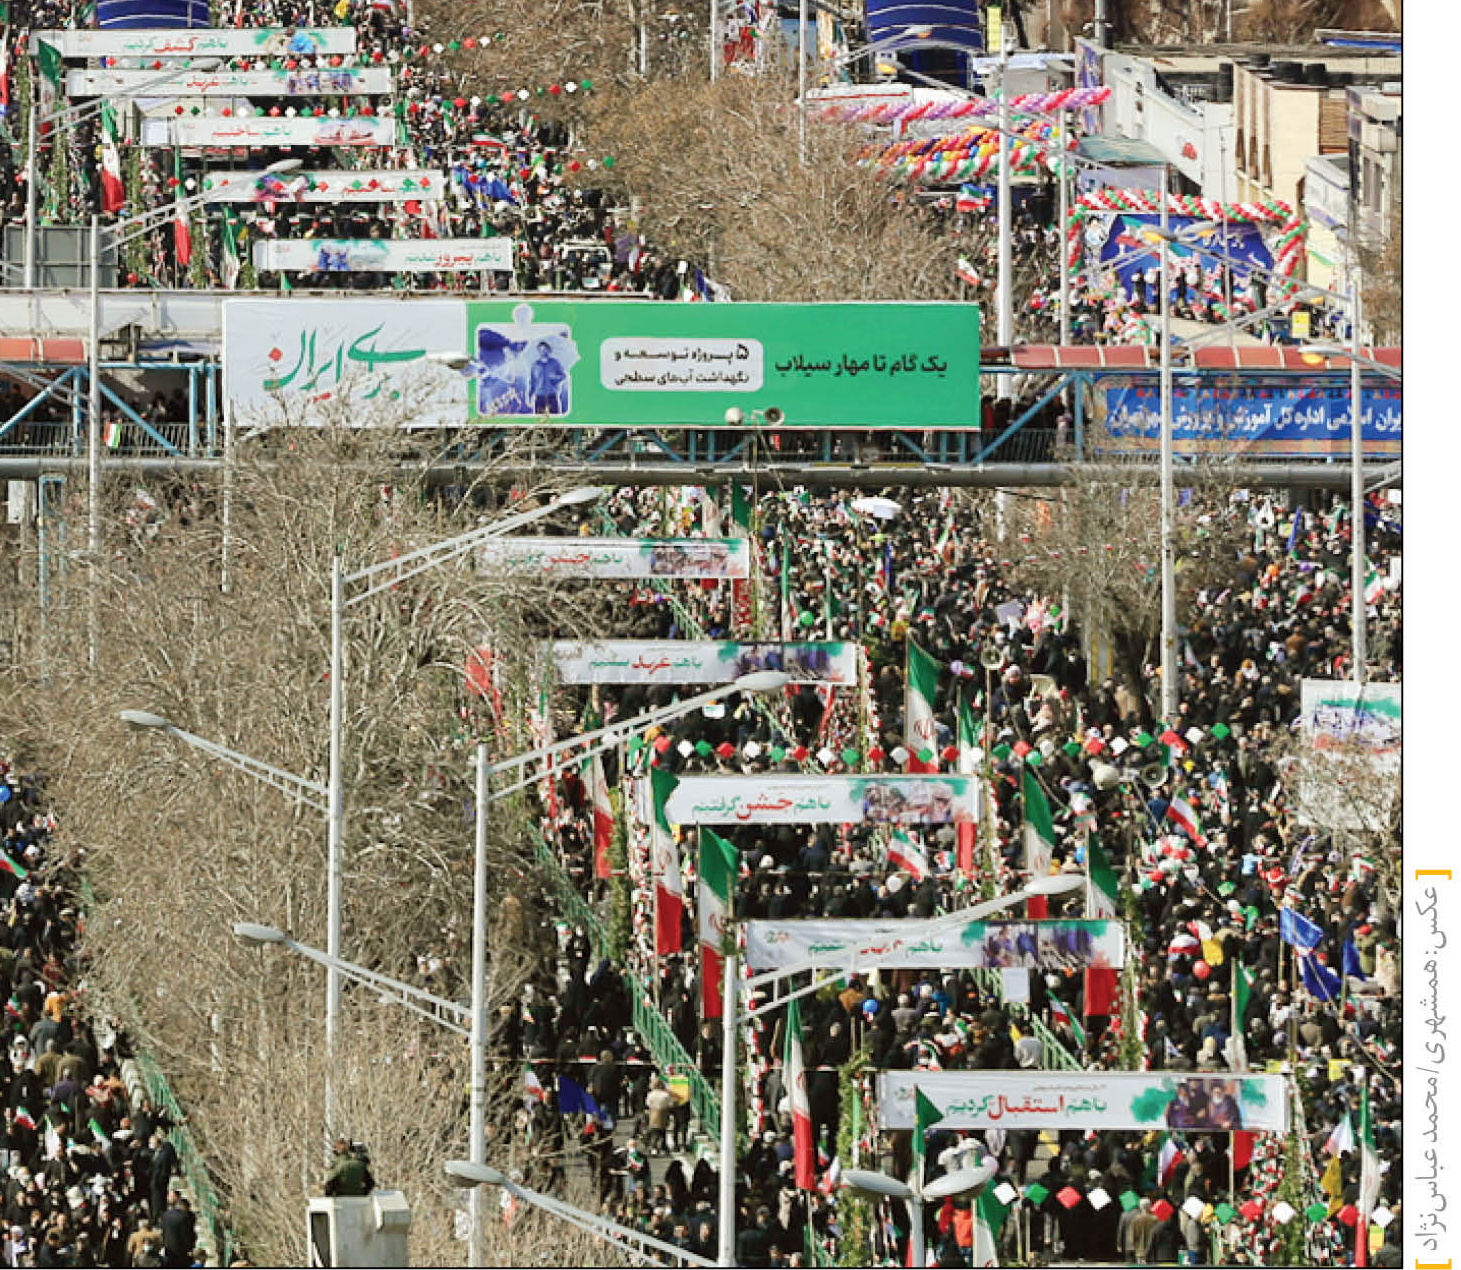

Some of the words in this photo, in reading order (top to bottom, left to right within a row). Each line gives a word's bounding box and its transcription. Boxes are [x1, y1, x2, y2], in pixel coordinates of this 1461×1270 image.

[736, 343, 749, 360] ۵
[775, 354, 831, 378] سیلاب
[834, 354, 870, 377] مهار
[873, 354, 887, 372] تا
[890, 354, 918, 376] گام
[921, 354, 947, 378] یک
[736, 792, 794, 820] جشن
[945, 1094, 991, 1116] کردیم
[988, 1095, 1065, 1120] استقبال
[1065, 1095, 1108, 1115] باهم
